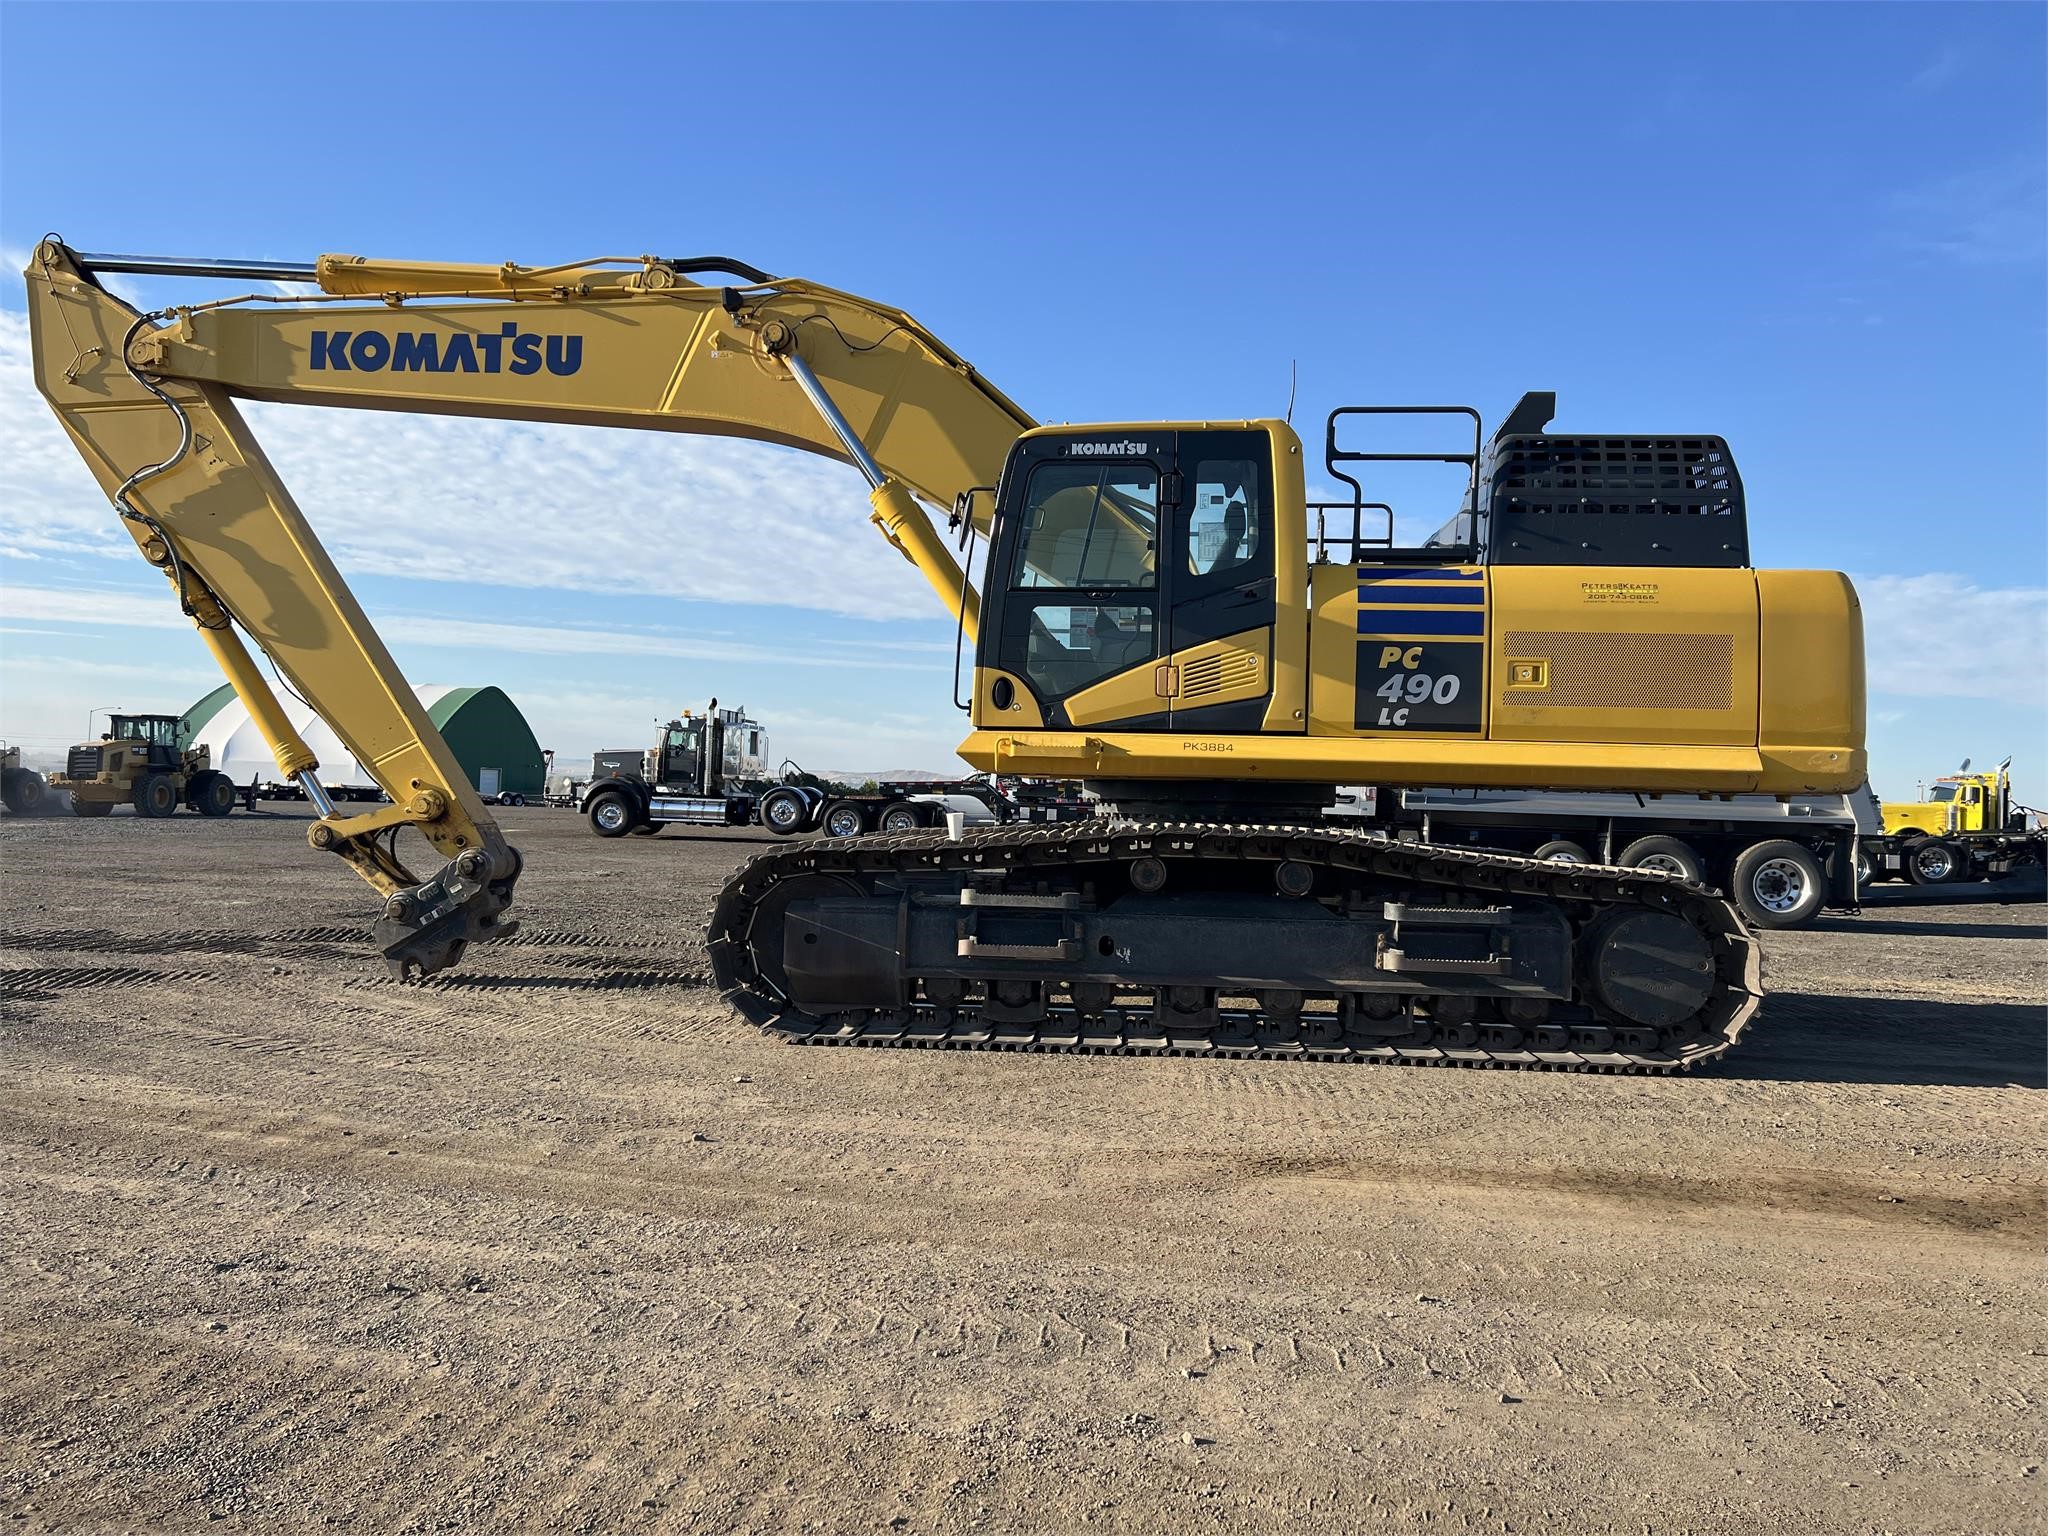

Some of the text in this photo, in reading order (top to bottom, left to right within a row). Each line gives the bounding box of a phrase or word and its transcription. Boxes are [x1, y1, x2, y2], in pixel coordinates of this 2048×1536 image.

[310, 322, 583, 376] KOMATSU
[1072, 440, 1147, 455] KOMATSU
[1379, 646, 1423, 670] PC
[1376, 673, 1460, 705] 490
[1378, 707, 1410, 726] LC
[1183, 742, 1234, 752] PK3884
